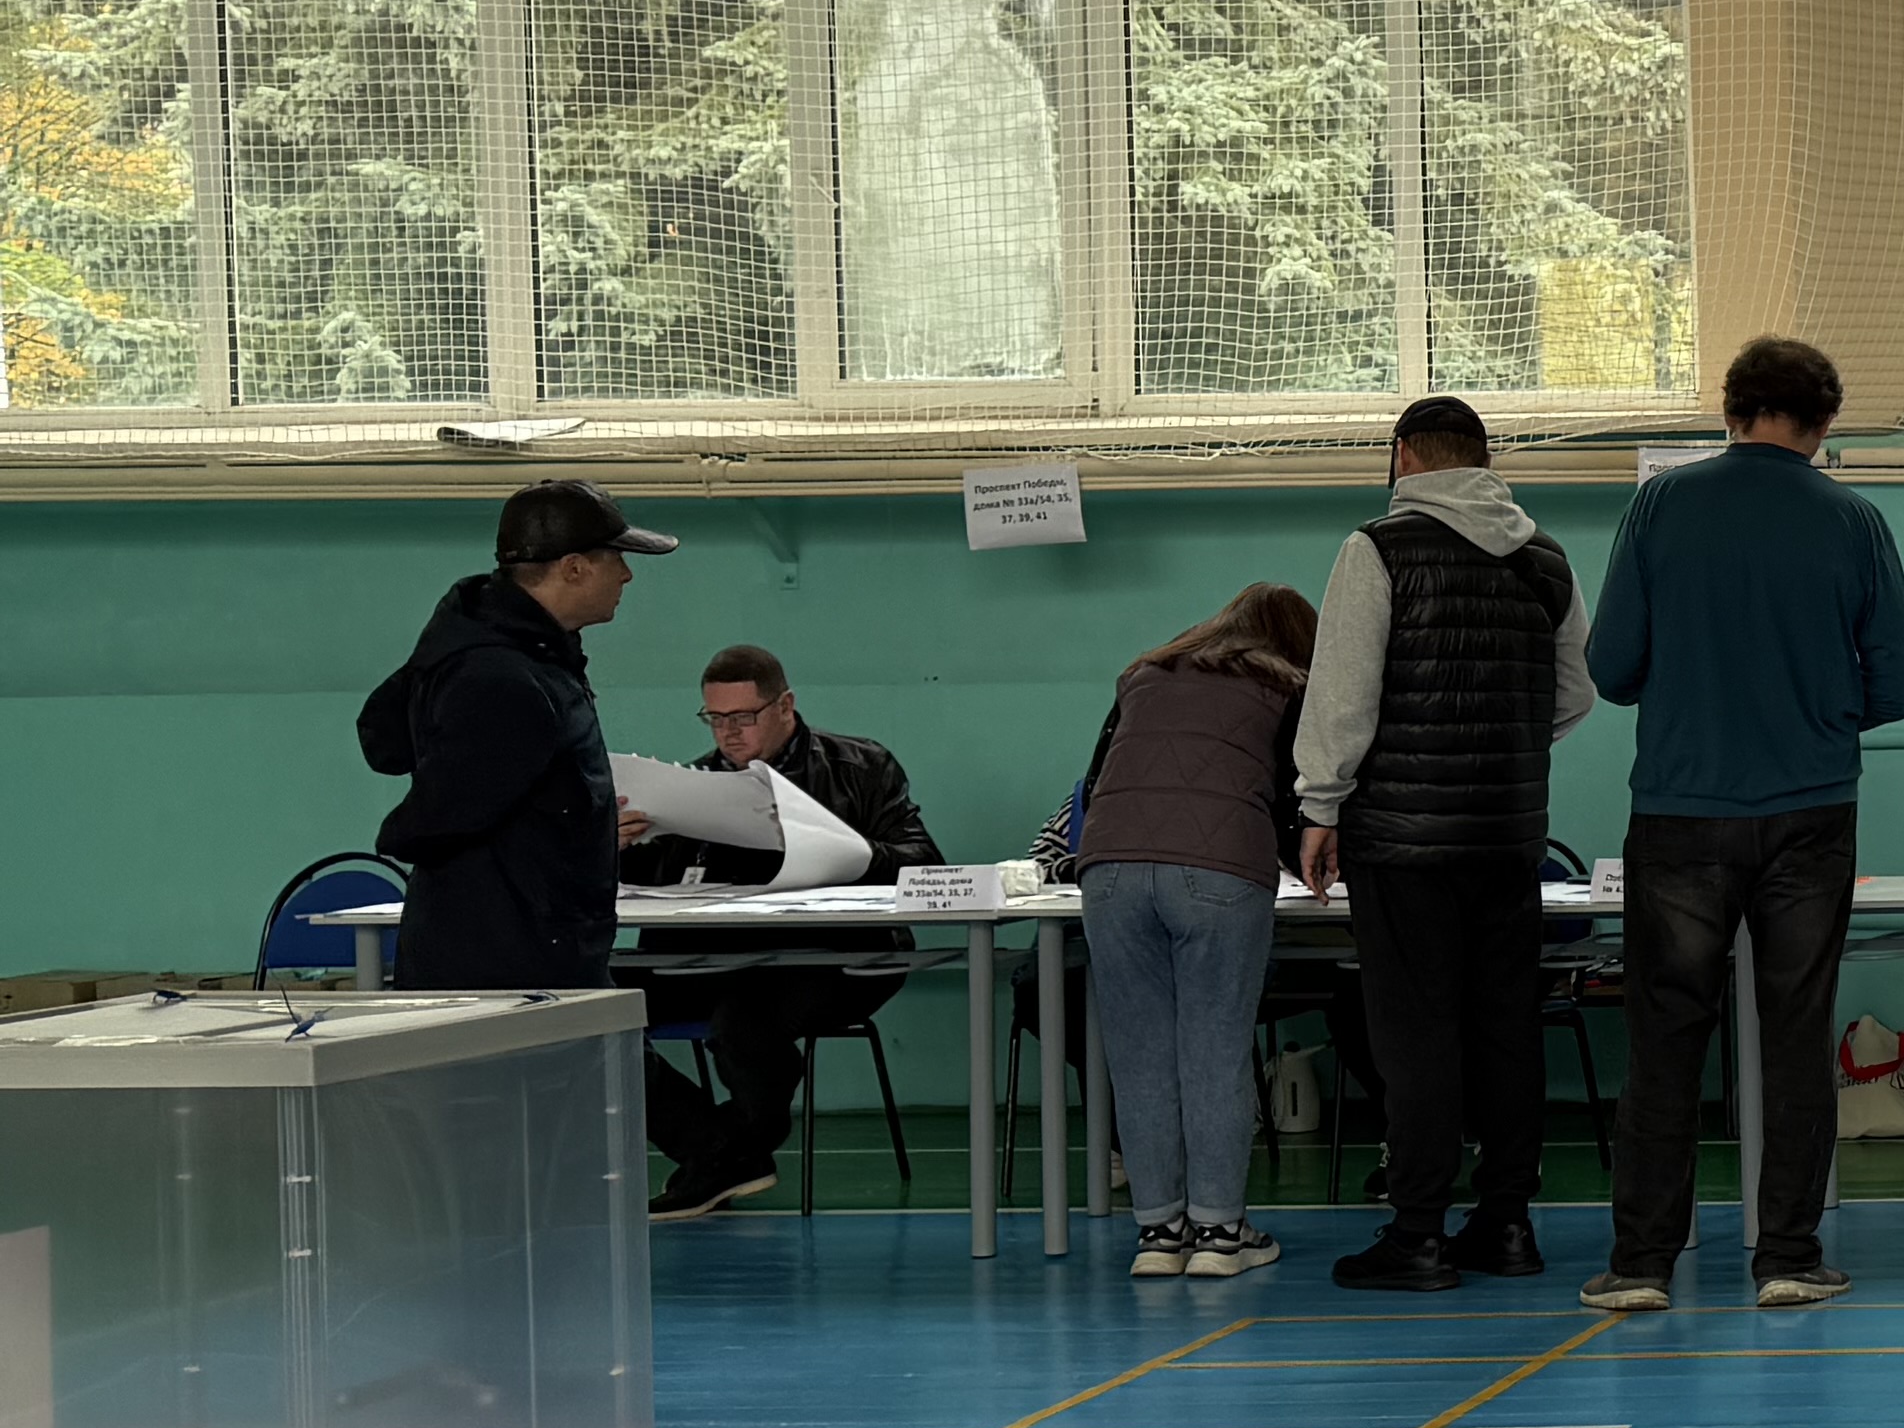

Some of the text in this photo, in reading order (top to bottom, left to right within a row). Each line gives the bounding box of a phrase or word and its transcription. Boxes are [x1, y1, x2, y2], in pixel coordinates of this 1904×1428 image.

[974, 478, 1067, 494] Проспект Победы,
[973, 501, 1001, 512] дома
[1057, 492, 1072, 503] 35,
[1002, 511, 1047, 524] 37, 39, 41
